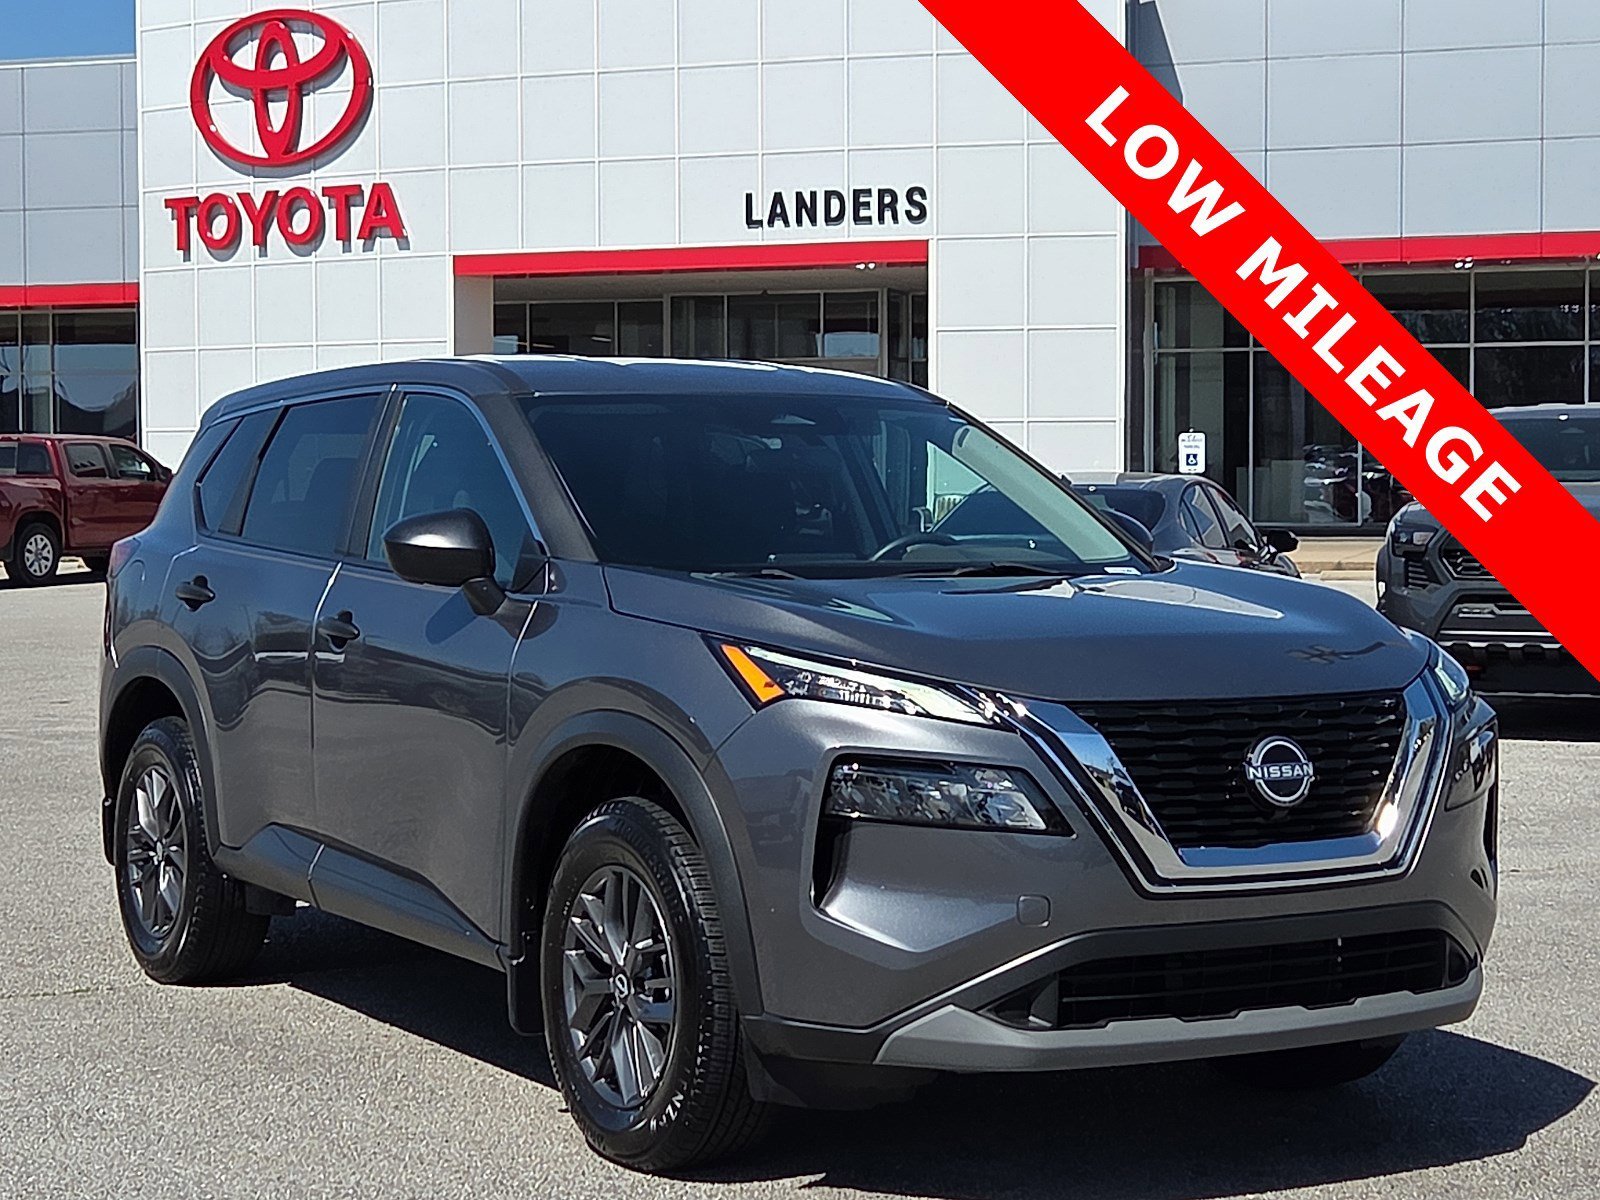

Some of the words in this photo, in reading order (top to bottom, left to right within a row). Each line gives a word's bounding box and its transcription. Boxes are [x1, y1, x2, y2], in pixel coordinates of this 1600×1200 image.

[164, 182, 408, 252] TOYOTA
[745, 186, 928, 229] LANDERS
[1248, 764, 1313, 779] NISSAN
